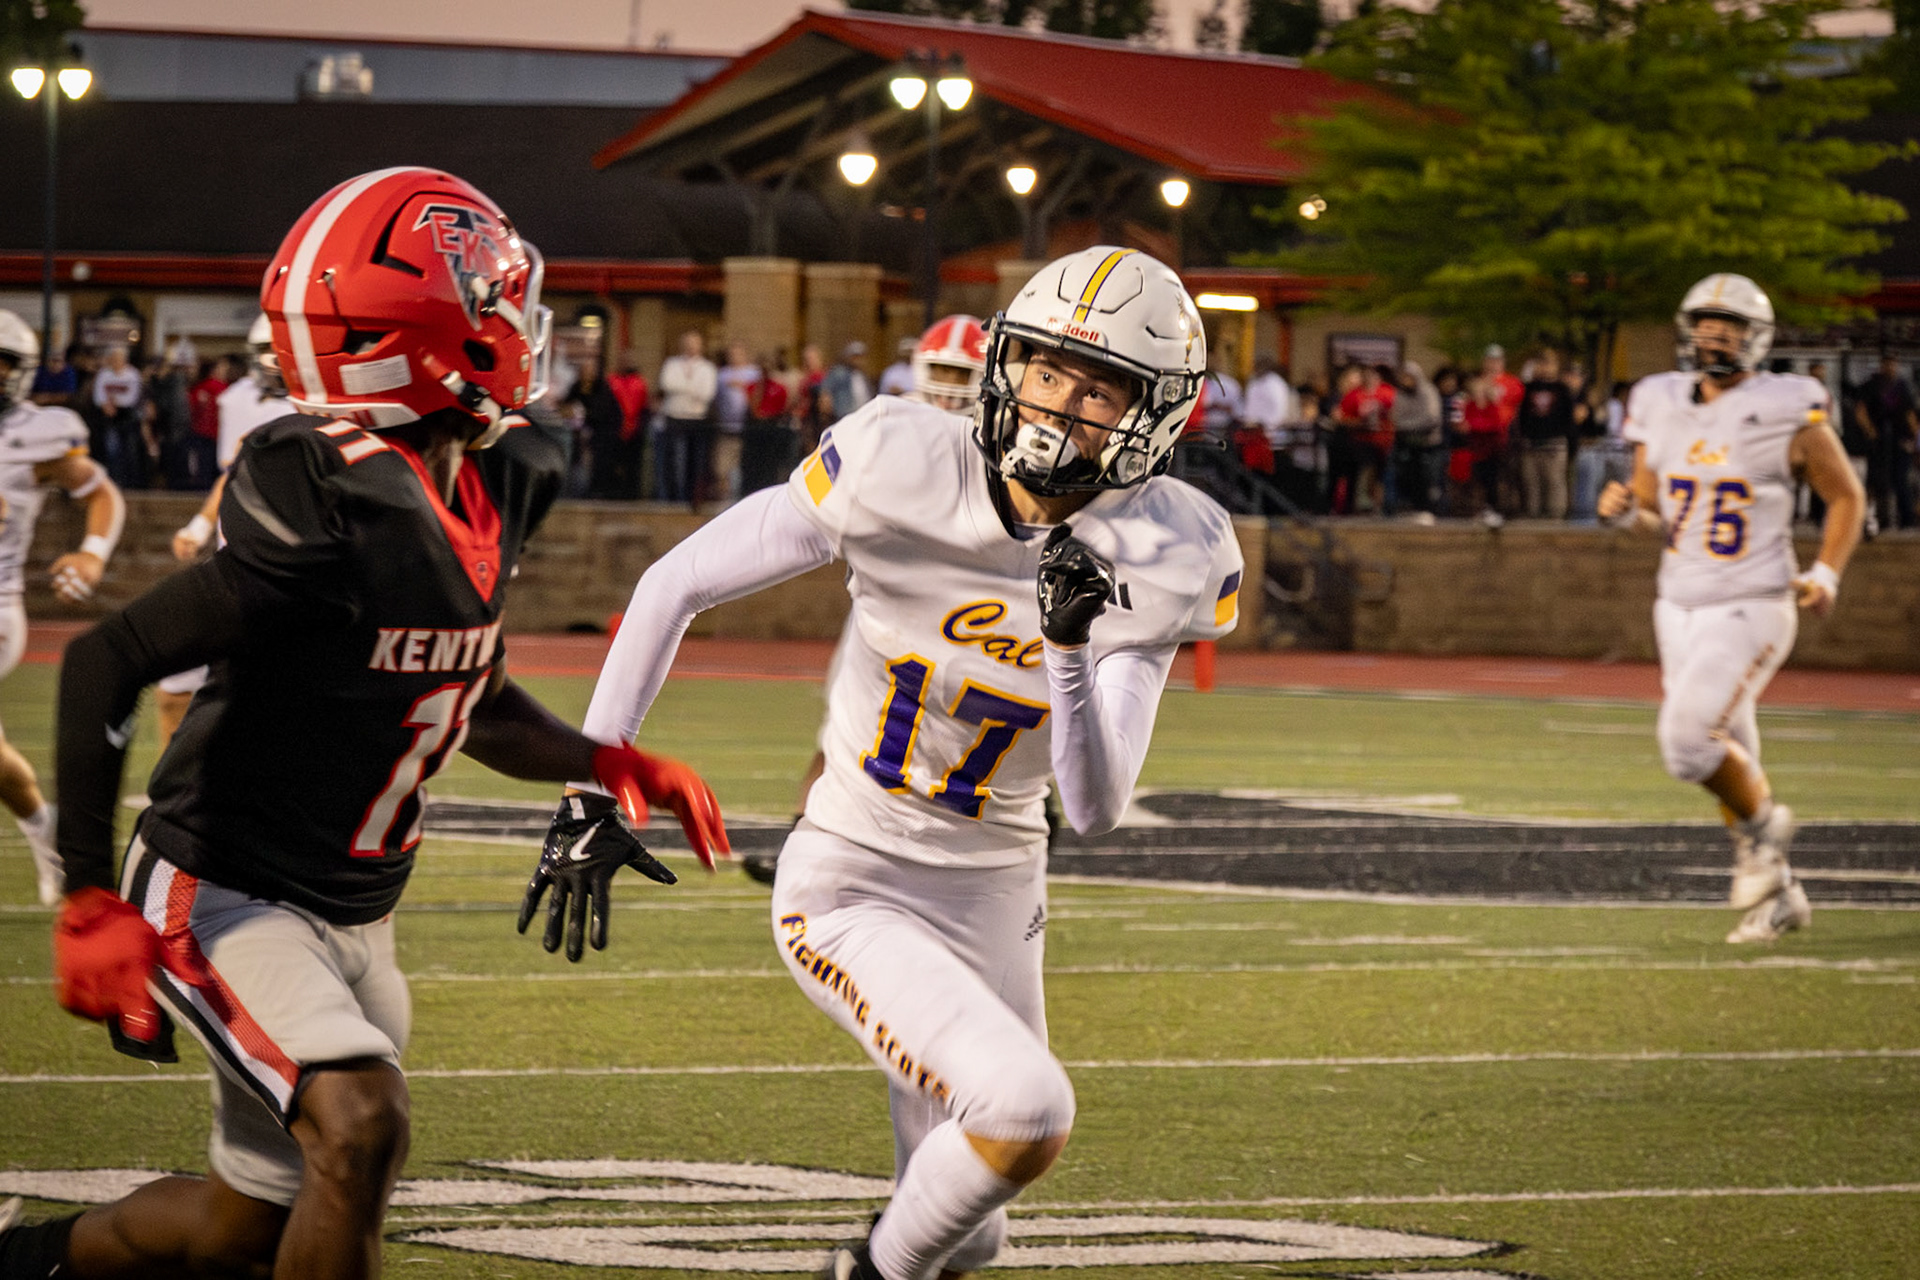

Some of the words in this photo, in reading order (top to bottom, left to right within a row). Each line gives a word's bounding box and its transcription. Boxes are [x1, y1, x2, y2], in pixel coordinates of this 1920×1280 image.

[1047, 317, 1099, 342] ddell
[1665, 473, 1756, 561] 76
[859, 653, 1052, 820] 17
[780, 912, 871, 1030] FIGHTING
